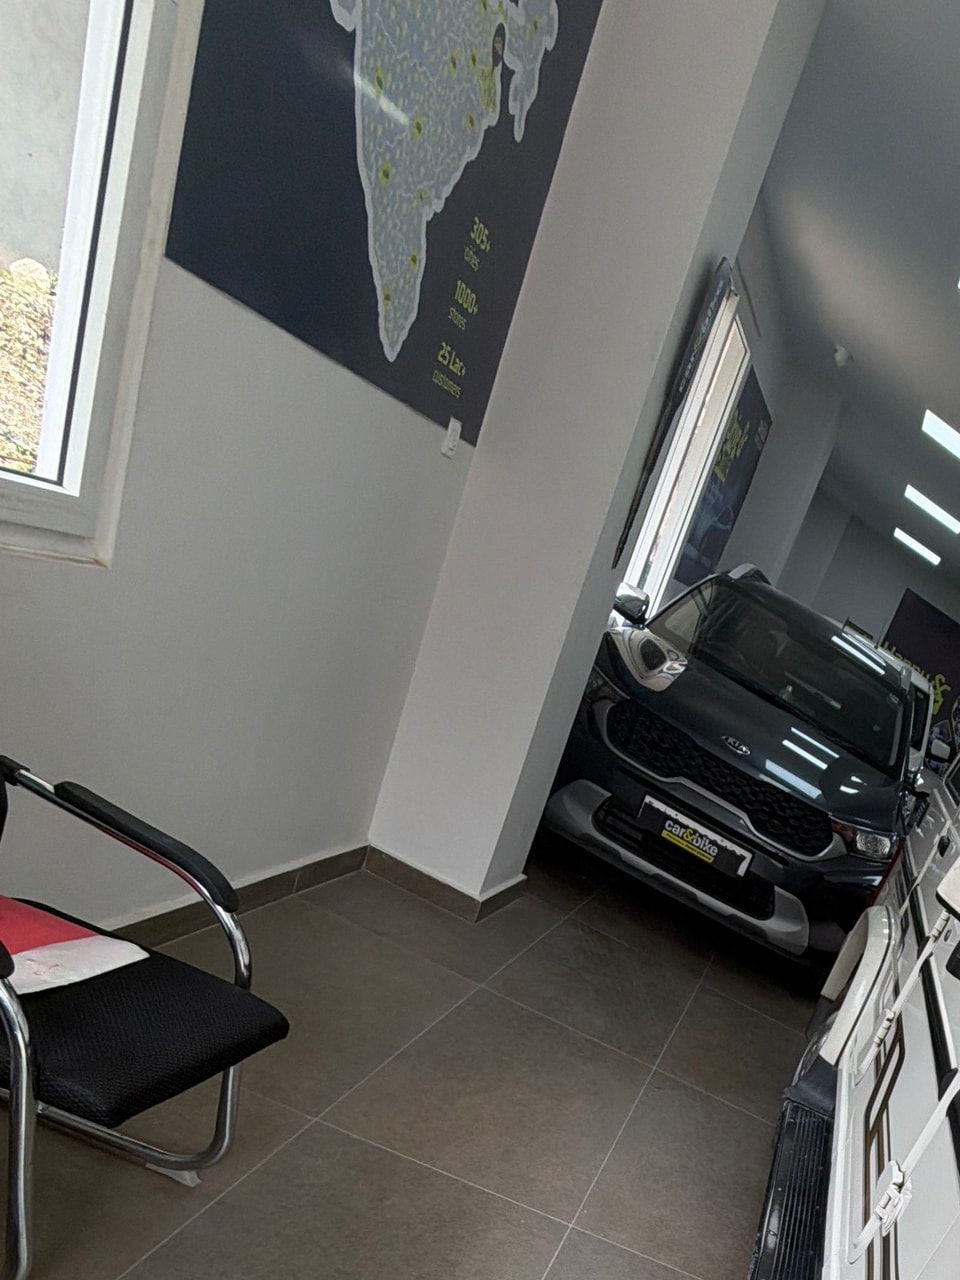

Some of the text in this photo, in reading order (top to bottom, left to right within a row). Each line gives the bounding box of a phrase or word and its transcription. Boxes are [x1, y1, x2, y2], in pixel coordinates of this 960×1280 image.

[470, 216, 491, 252] 305+
[455, 279, 478, 315] 1000+
[437, 341, 451, 366] 25
[664, 819, 719, 856] car&bike
